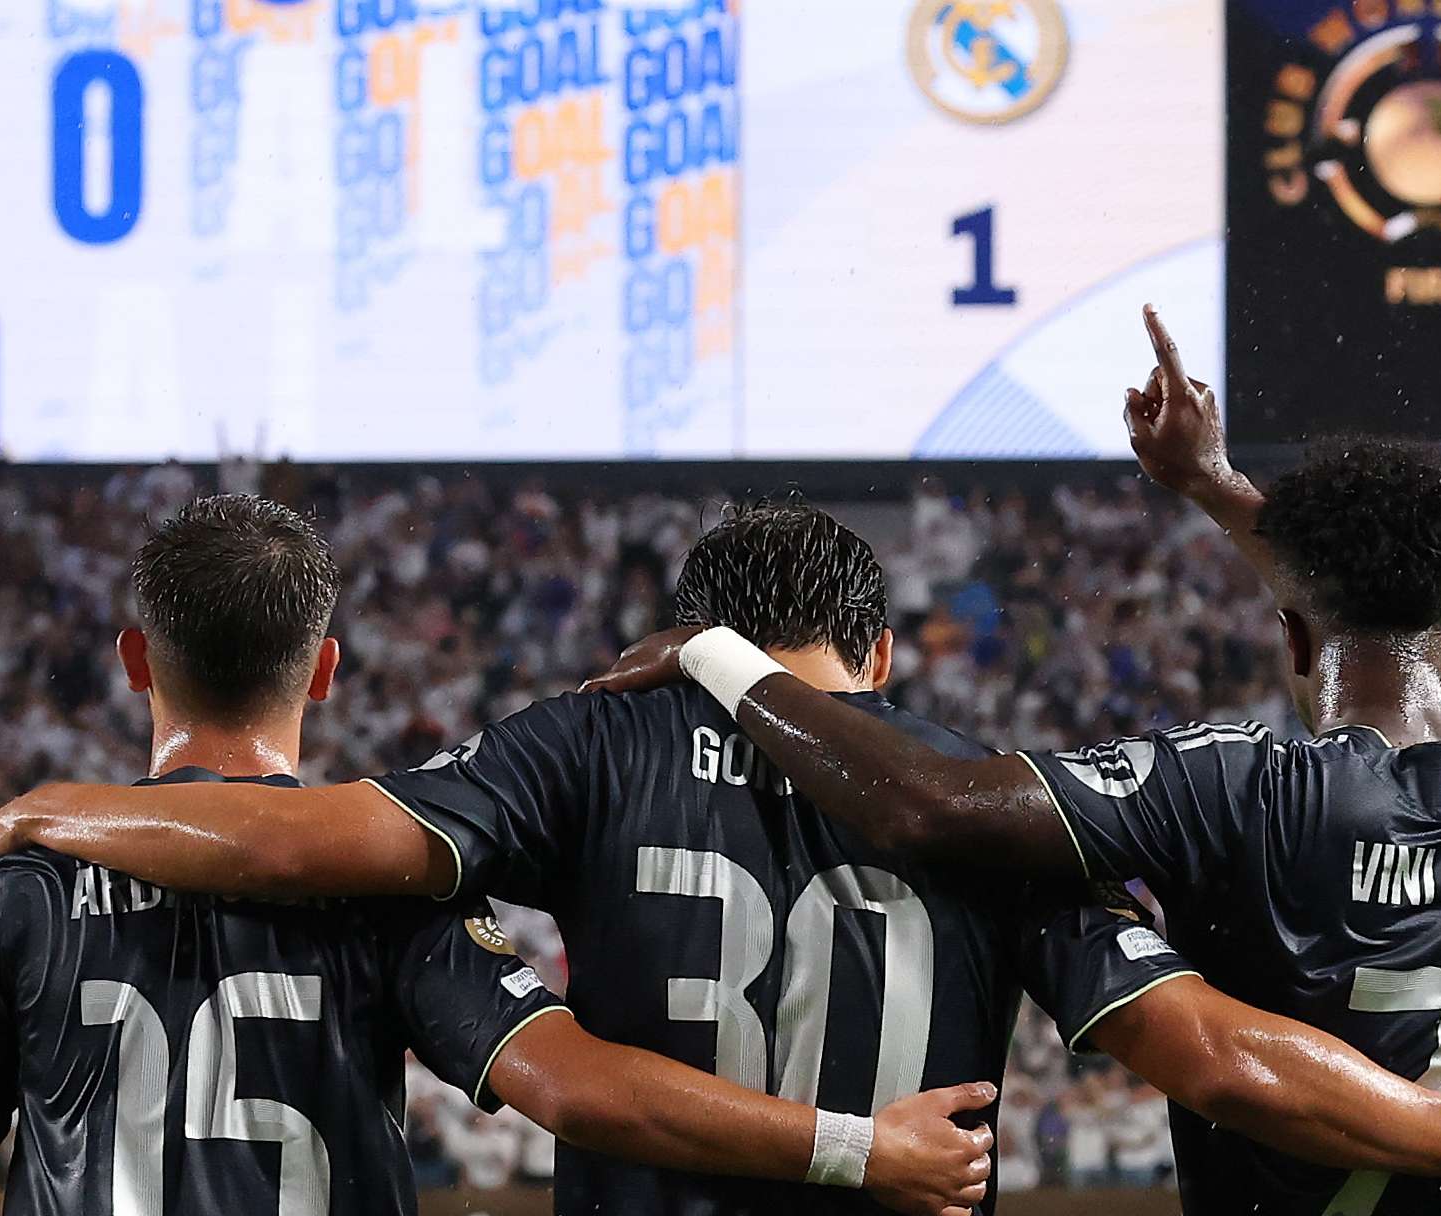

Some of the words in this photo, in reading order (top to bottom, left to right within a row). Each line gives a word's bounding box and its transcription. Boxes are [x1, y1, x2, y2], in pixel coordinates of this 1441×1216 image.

[949, 204, 1017, 306] 1
[1351, 841, 1436, 906] VINI
[636, 846, 935, 1110] 30
